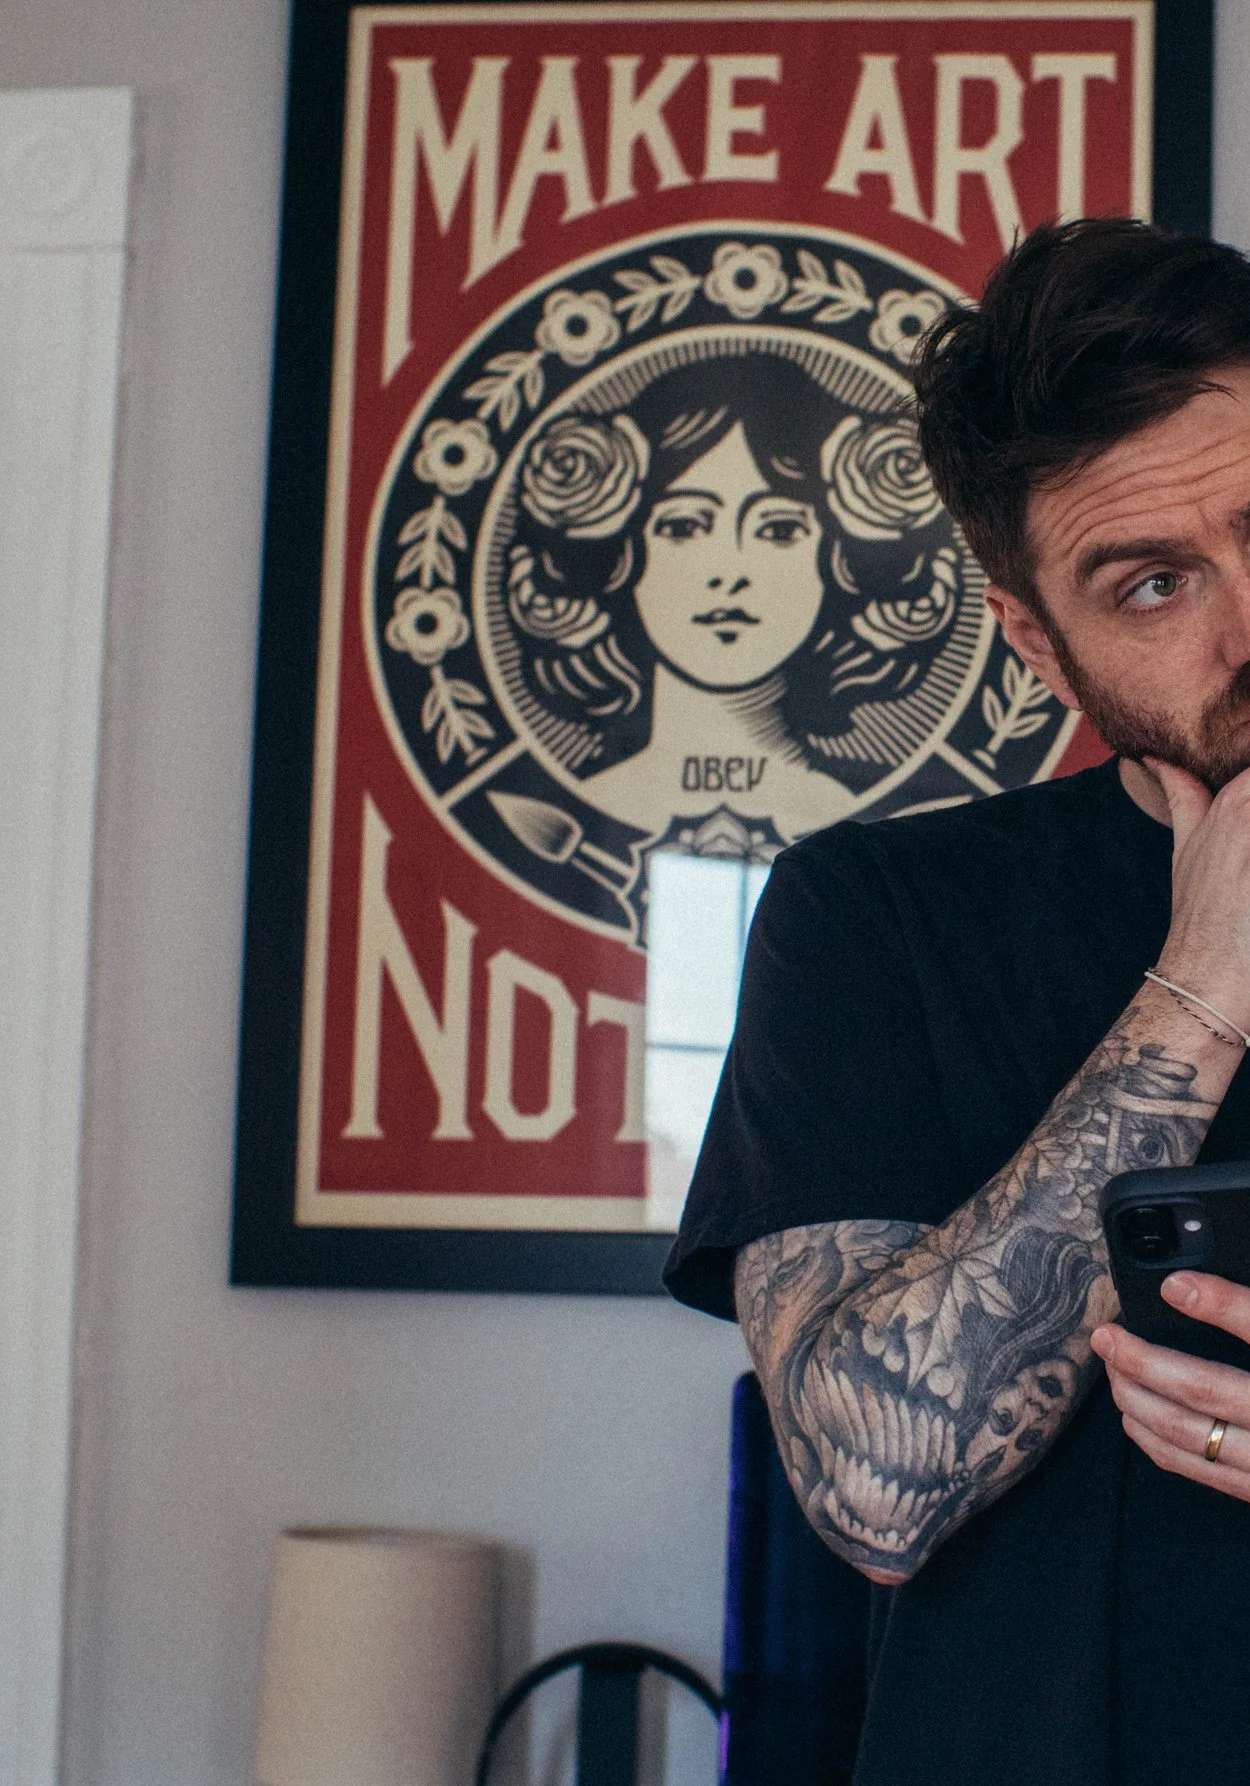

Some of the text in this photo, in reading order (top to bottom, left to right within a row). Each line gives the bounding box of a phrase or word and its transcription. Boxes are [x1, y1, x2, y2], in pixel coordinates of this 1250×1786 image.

[382, 52, 1118, 388] MAKE ART
[682, 755, 767, 791] OBEY
